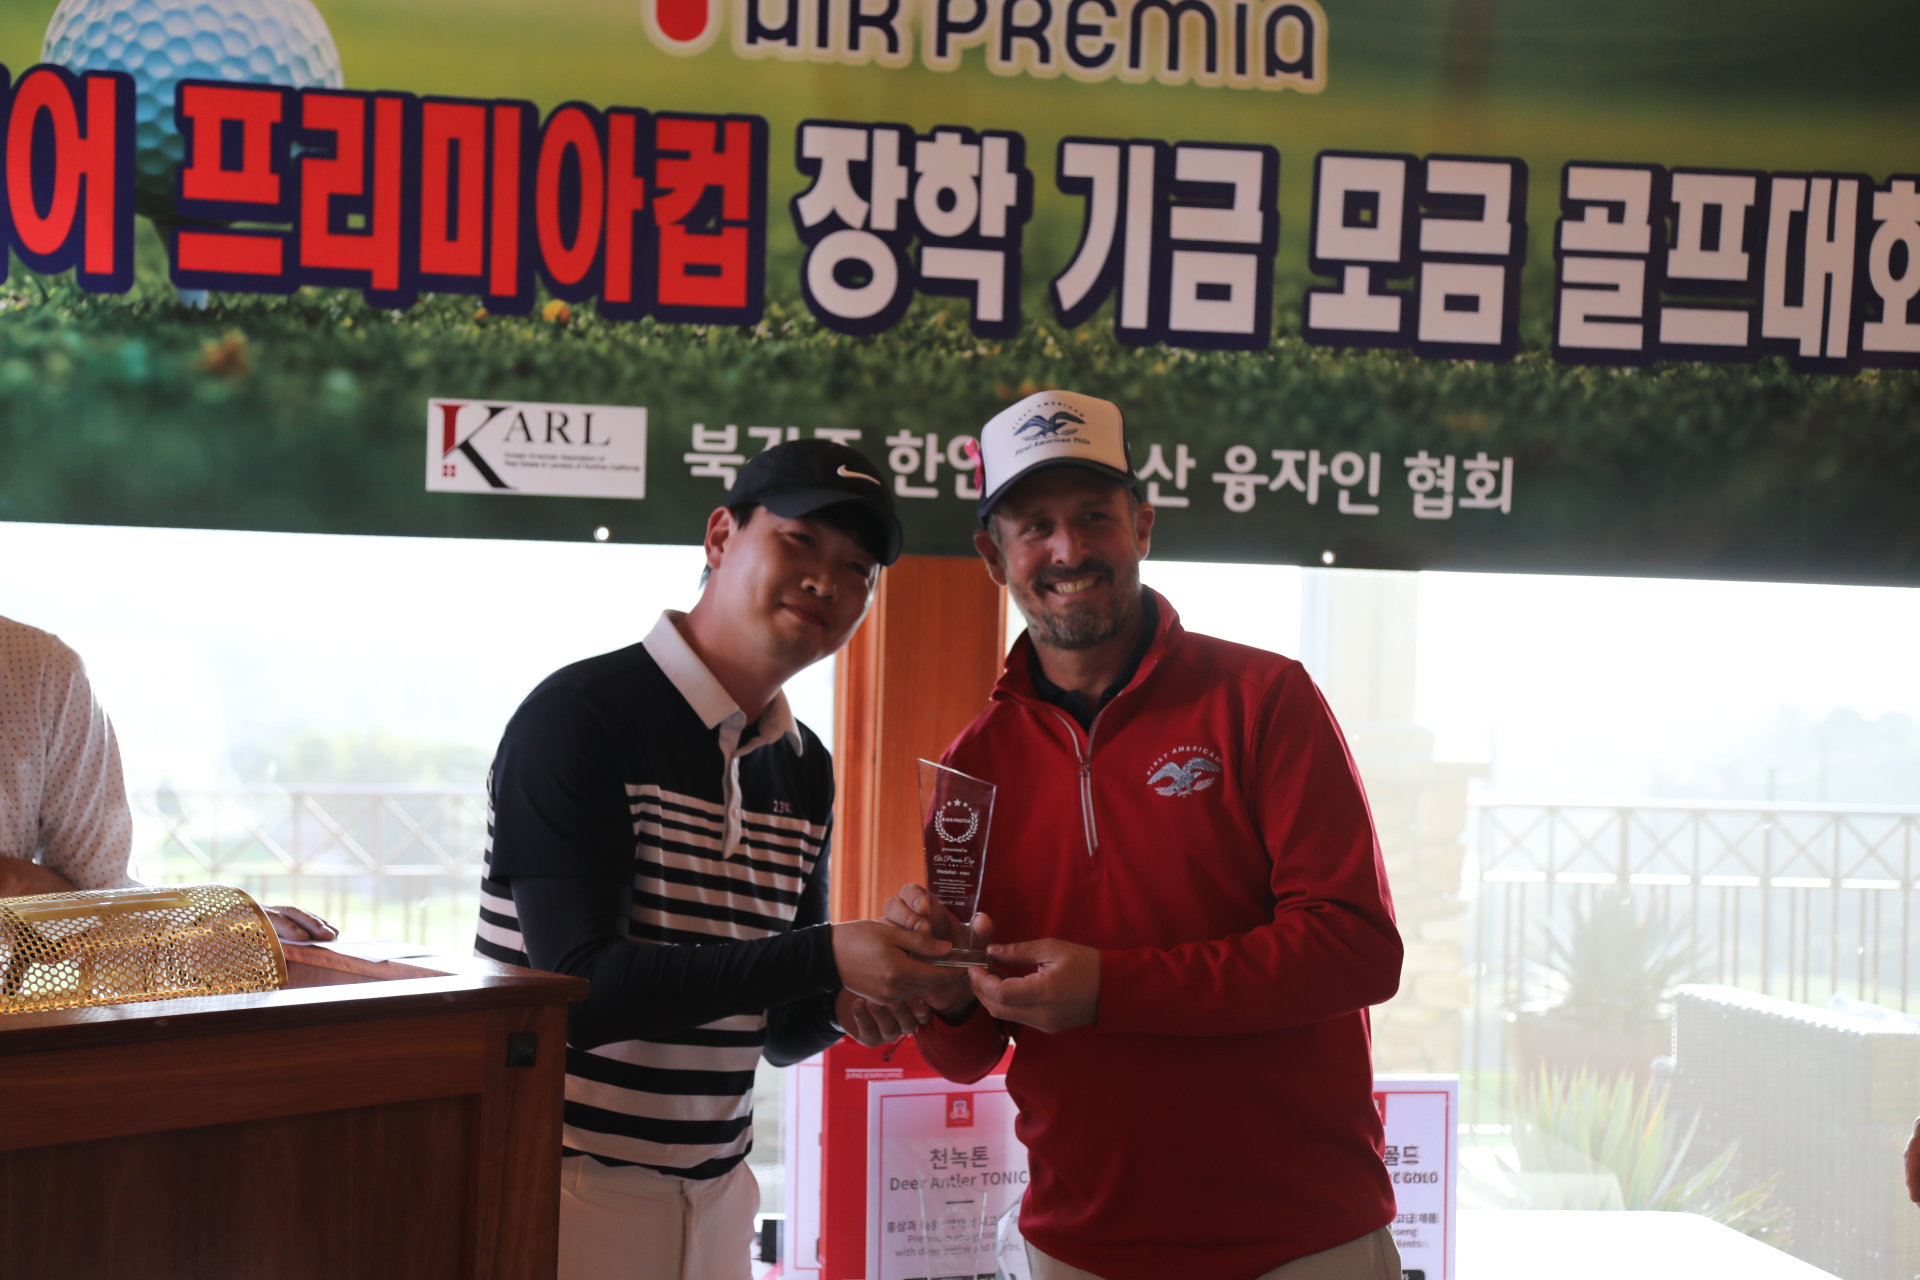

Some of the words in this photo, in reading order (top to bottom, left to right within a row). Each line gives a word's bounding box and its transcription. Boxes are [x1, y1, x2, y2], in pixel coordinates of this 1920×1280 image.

[177, 84, 752, 308] 프리미아컵
[797, 125, 1017, 322] 장학
[1056, 142, 1264, 335] 기금
[1308, 156, 1512, 345] 모금
[434, 402, 612, 491] KARL
[1033, 437, 1072, 447] American
[1211, 444, 1381, 516] 융자인
[1403, 450, 1514, 520] 협회
[1146, 752, 1169, 776] FIRST
[1172, 745, 1222, 763] AMERICAN
[929, 1146, 990, 1171] 천녹톤
[889, 1177, 926, 1191] Deer
[930, 1173, 977, 1189] Antler
[980, 1170, 1028, 1186] TONIC
